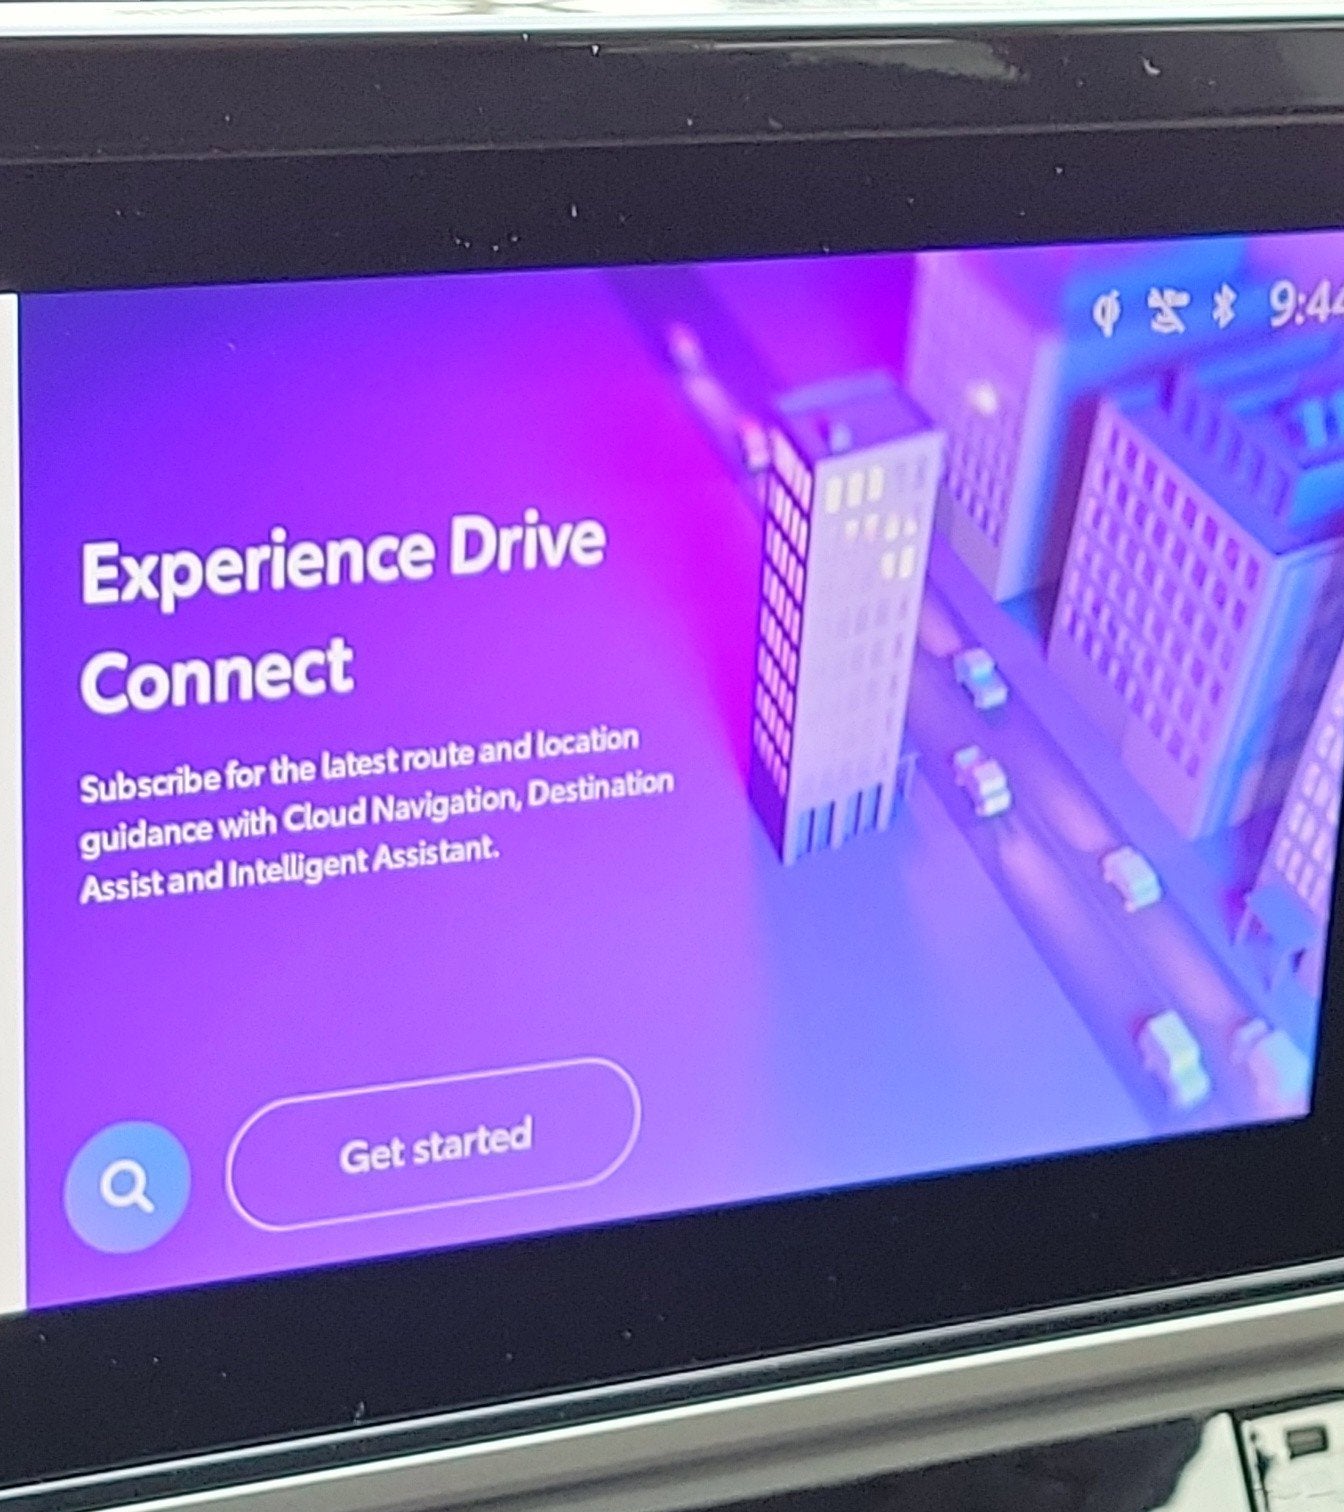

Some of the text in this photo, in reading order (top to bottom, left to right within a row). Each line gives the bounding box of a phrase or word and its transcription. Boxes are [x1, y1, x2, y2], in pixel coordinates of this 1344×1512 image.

[81, 507, 607, 614] Experience Drive
[80, 635, 354, 715] Connect
[80, 724, 640, 803] Subscribe for the latest route and location
[80, 769, 674, 860] guidance with Cloud Navigation, Destination
[80, 834, 500, 905] Assist and Intelligent Assistant.
[339, 1115, 533, 1175] Get started
